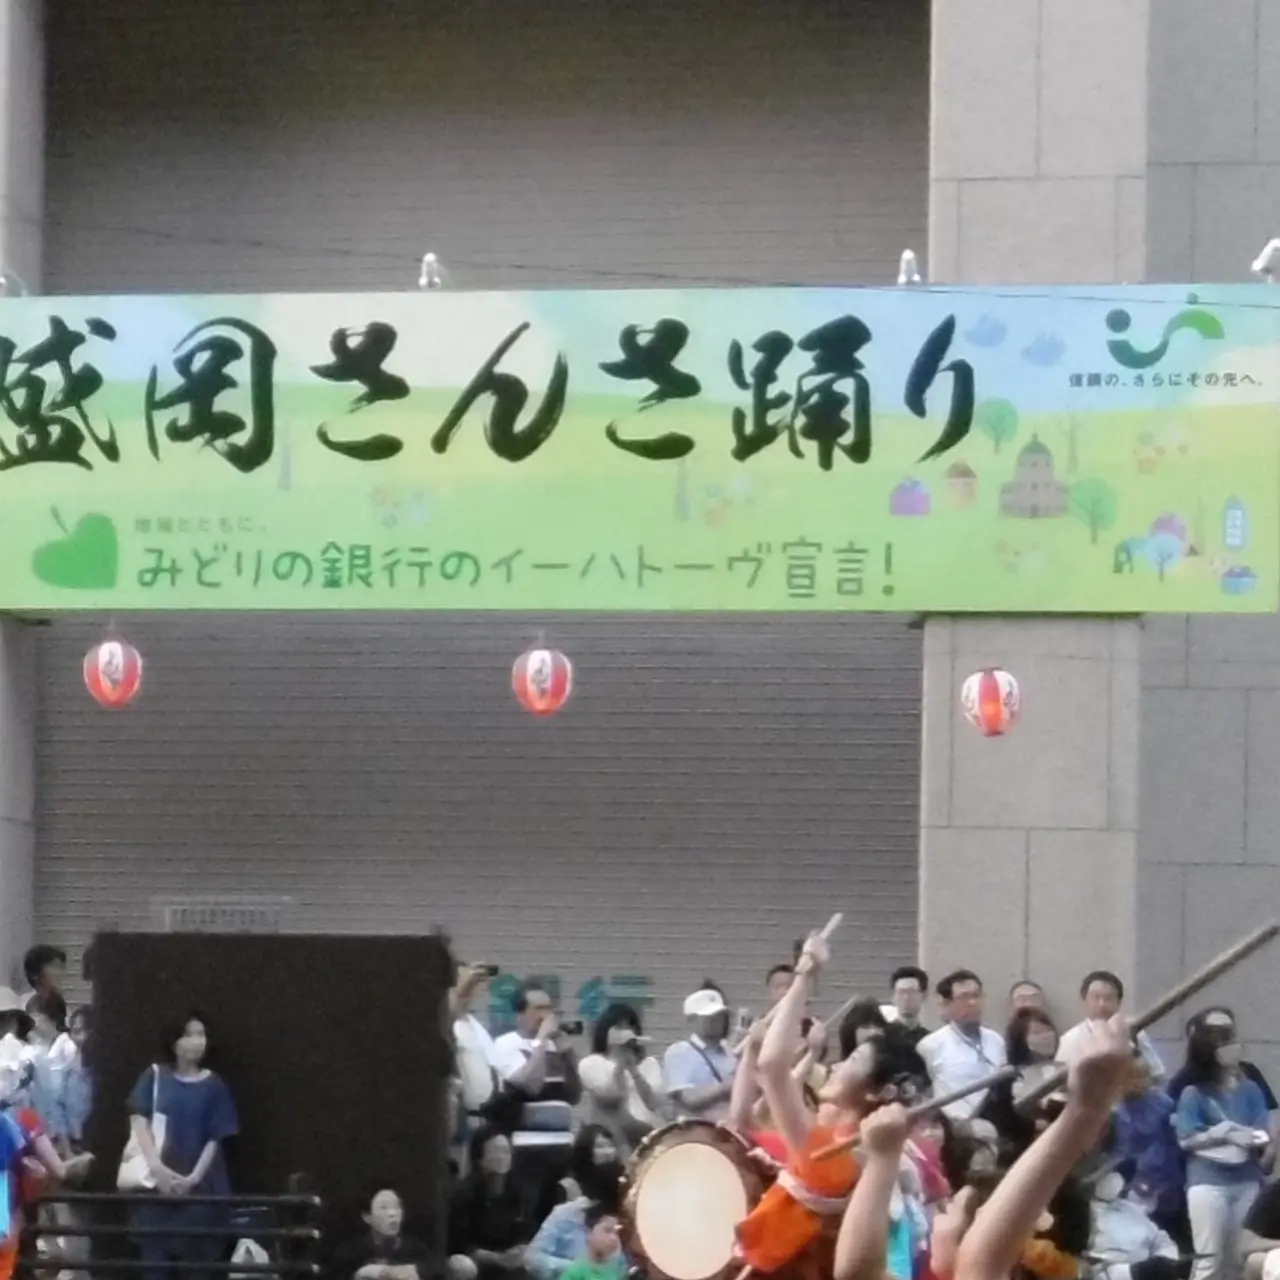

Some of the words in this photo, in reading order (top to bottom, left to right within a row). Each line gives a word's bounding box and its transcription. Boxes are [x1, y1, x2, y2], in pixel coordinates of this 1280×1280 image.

[136, 536, 895, 599] みどりの銀行のイーハトーヴ宣言！
